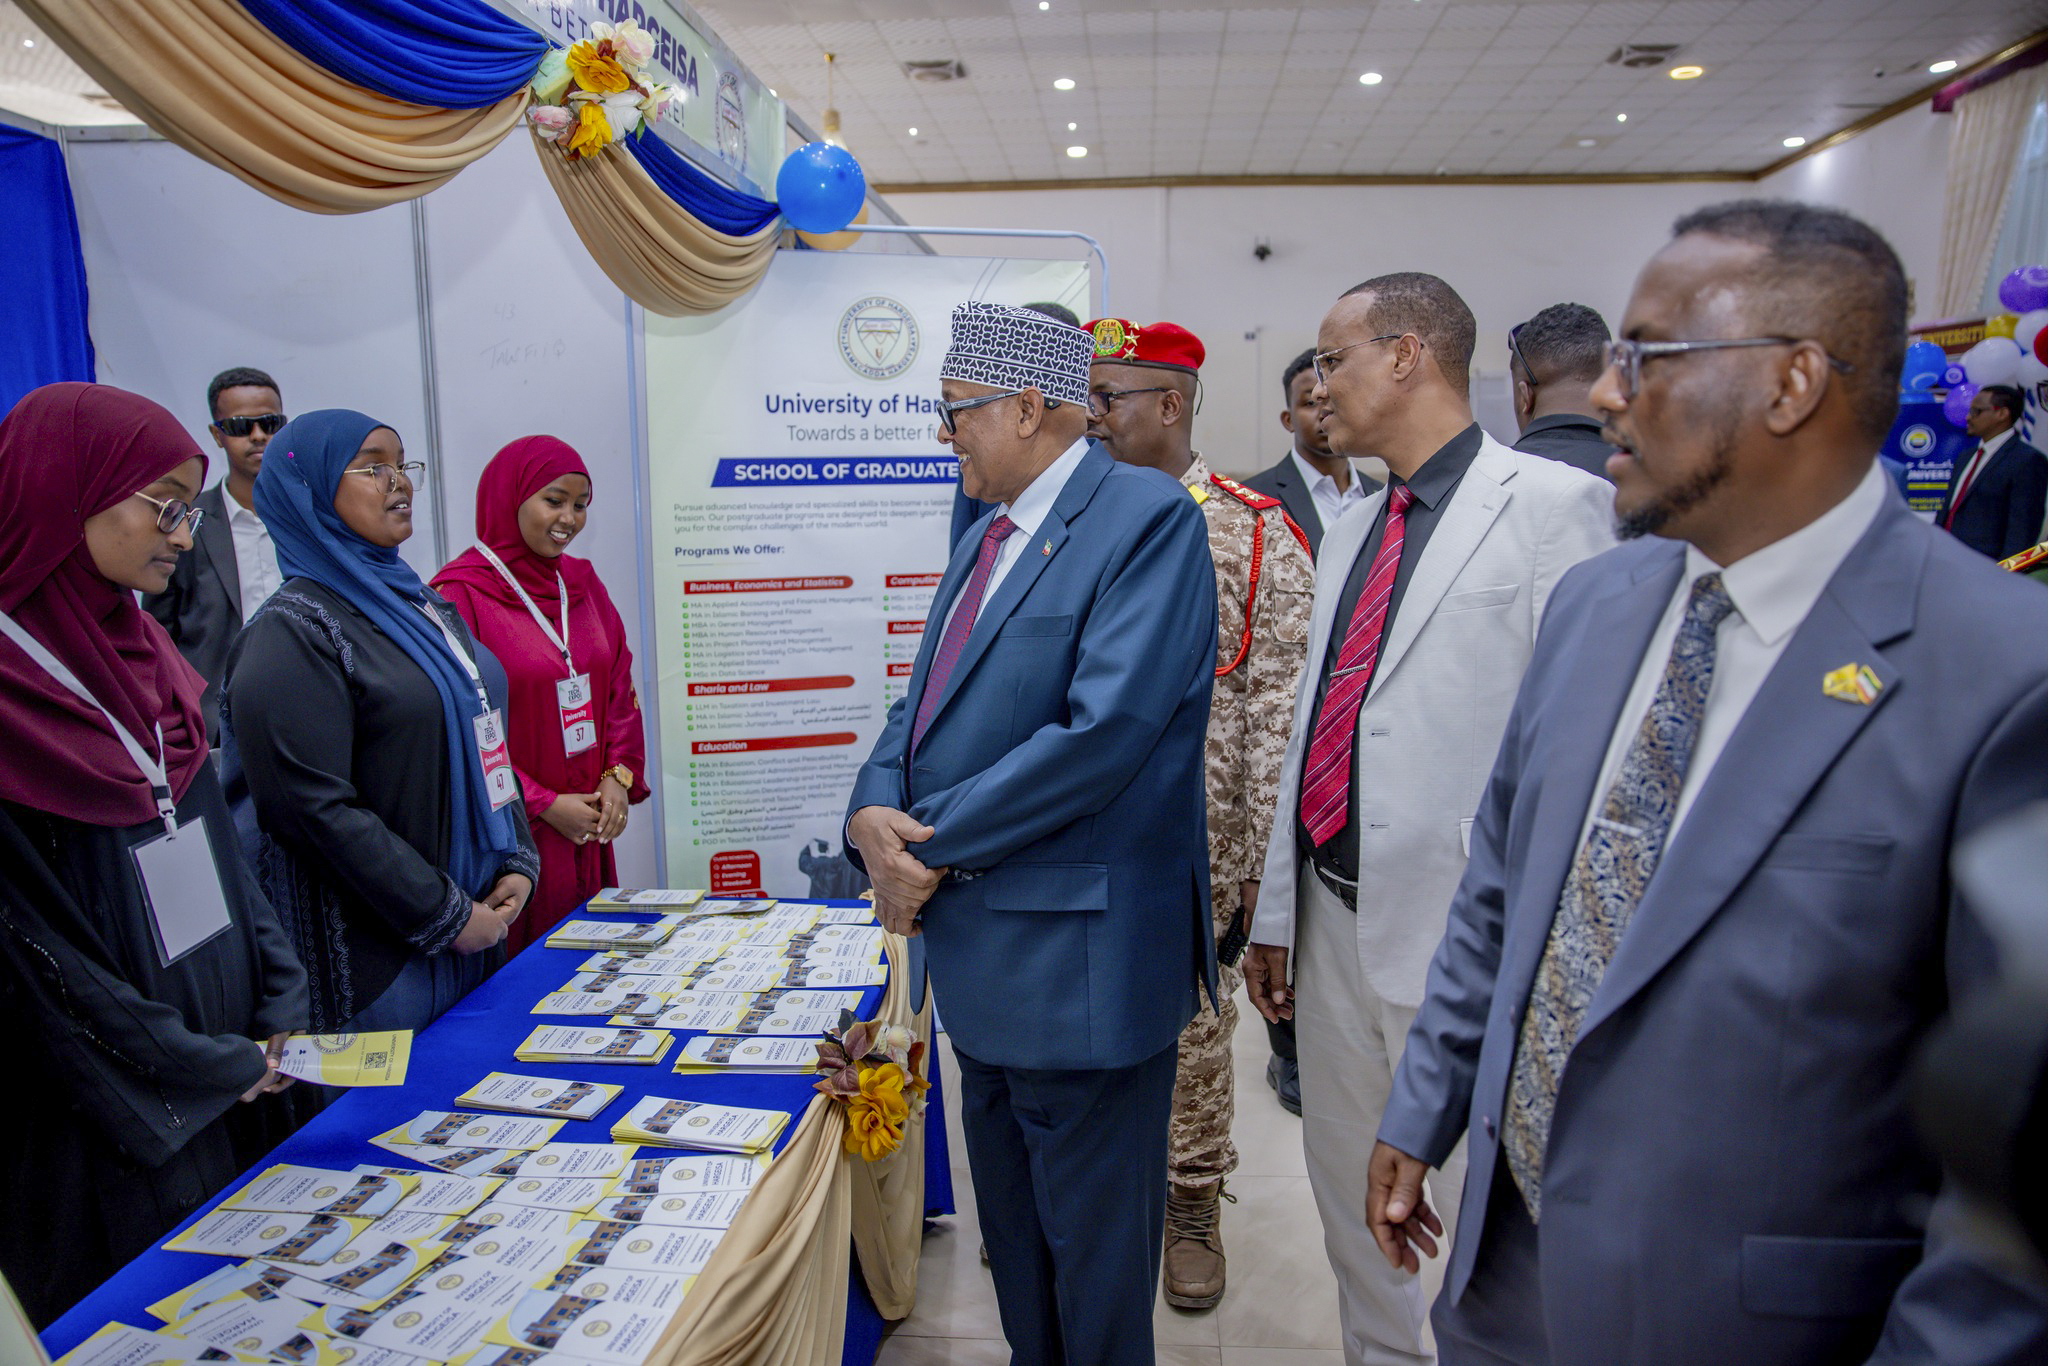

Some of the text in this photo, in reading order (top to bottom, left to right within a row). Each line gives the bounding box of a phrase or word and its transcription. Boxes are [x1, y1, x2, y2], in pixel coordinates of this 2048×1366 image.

[765, 394, 873, 418] University
[879, 394, 900, 413] of
[787, 425, 855, 441] Towards
[860, 429, 869, 441] a
[874, 425, 921, 440] better
[734, 462, 959, 482] SCHOOL OF GRADUATE
[674, 503, 703, 511] Pursue
[705, 502, 747, 510] advanced
[748, 501, 793, 510] knowledge
[794, 500, 811, 508] and
[812, 499, 856, 509] specialized
[858, 499, 878, 507] skills
[880, 498, 889, 506] to
[890, 498, 921, 506] become
[674, 513, 706, 522] fession.
[708, 513, 724, 521] Our
[726, 512, 782, 522] postgraduate
[784, 512, 824, 521] programs
[841, 510, 877, 519] designed
[879, 509, 888, 517] to
[889, 509, 917, 518] deepen
[919, 510, 937, 518] your
[674, 525, 690, 534] you
[692, 523, 704, 531] for
[707, 523, 721, 531] the
[722, 522, 757, 532] complex
[759, 521, 803, 531] challenges
[805, 521, 814, 529] of
[816, 520, 829, 528] the
[831, 520, 862, 528] modern
[674, 544, 784, 558] Programs We Offer:
[689, 577, 844, 592] Business, Economics and Statistics
[694, 682, 770, 695] Sharia and Law
[565, 710, 587, 722] University
[575, 727, 584, 742] 37
[698, 741, 747, 753] Education
[484, 753, 503, 766] University
[715, 1114, 738, 1136] HARGEISA
[568, 1151, 589, 1172] HARGEISA
[712, 1162, 723, 1185] HARGEISA
[423, 1182, 454, 1206] HARGEISA
[696, 1195, 717, 1220] HARGEISA
[662, 1236, 685, 1264] HARGEISA
[417, 1312, 461, 1346] HARGEISA
[616, 1318, 648, 1352] HARGEISA
